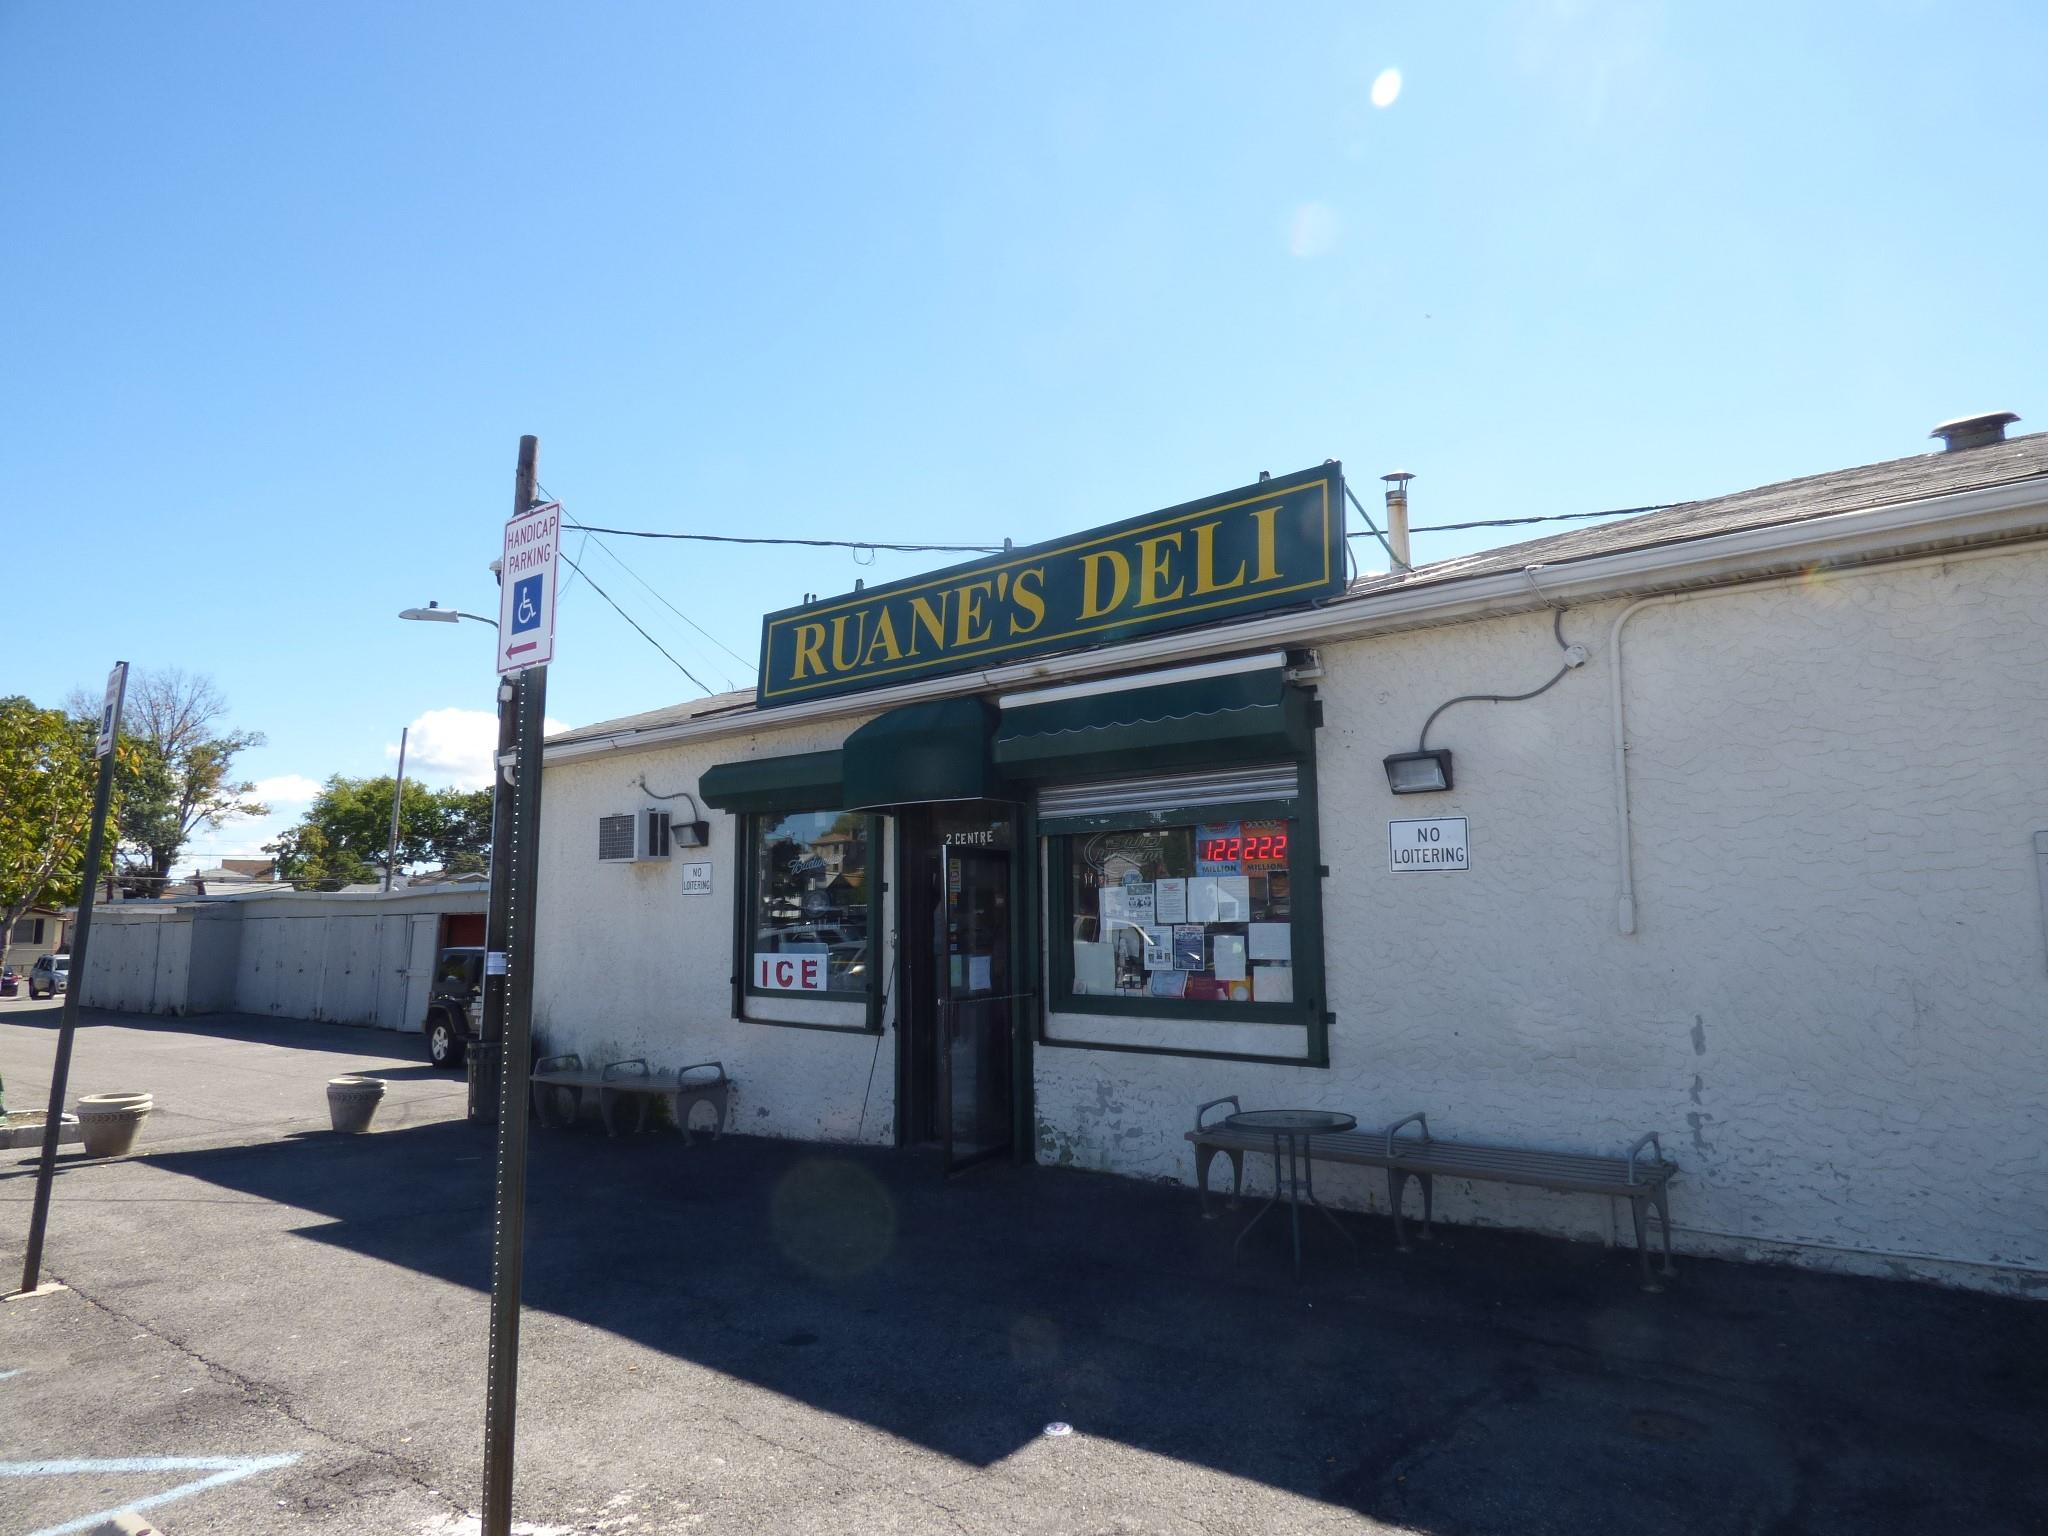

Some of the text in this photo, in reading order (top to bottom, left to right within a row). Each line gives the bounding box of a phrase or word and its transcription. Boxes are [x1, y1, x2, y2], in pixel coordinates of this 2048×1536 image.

[507, 516, 556, 550] HANDICAP
[509, 543, 550, 574] PARKING
[789, 506, 1283, 680] RUANE'S DELI
[945, 830, 993, 845] 2 CENTRE
[1417, 827, 1440, 842] NO
[1394, 847, 1465, 864] LOITERING
[692, 867, 702, 878] NO
[1202, 864, 1237, 873] MILLION
[1247, 863, 1284, 871] MILLION
[762, 959, 818, 989] ICE
